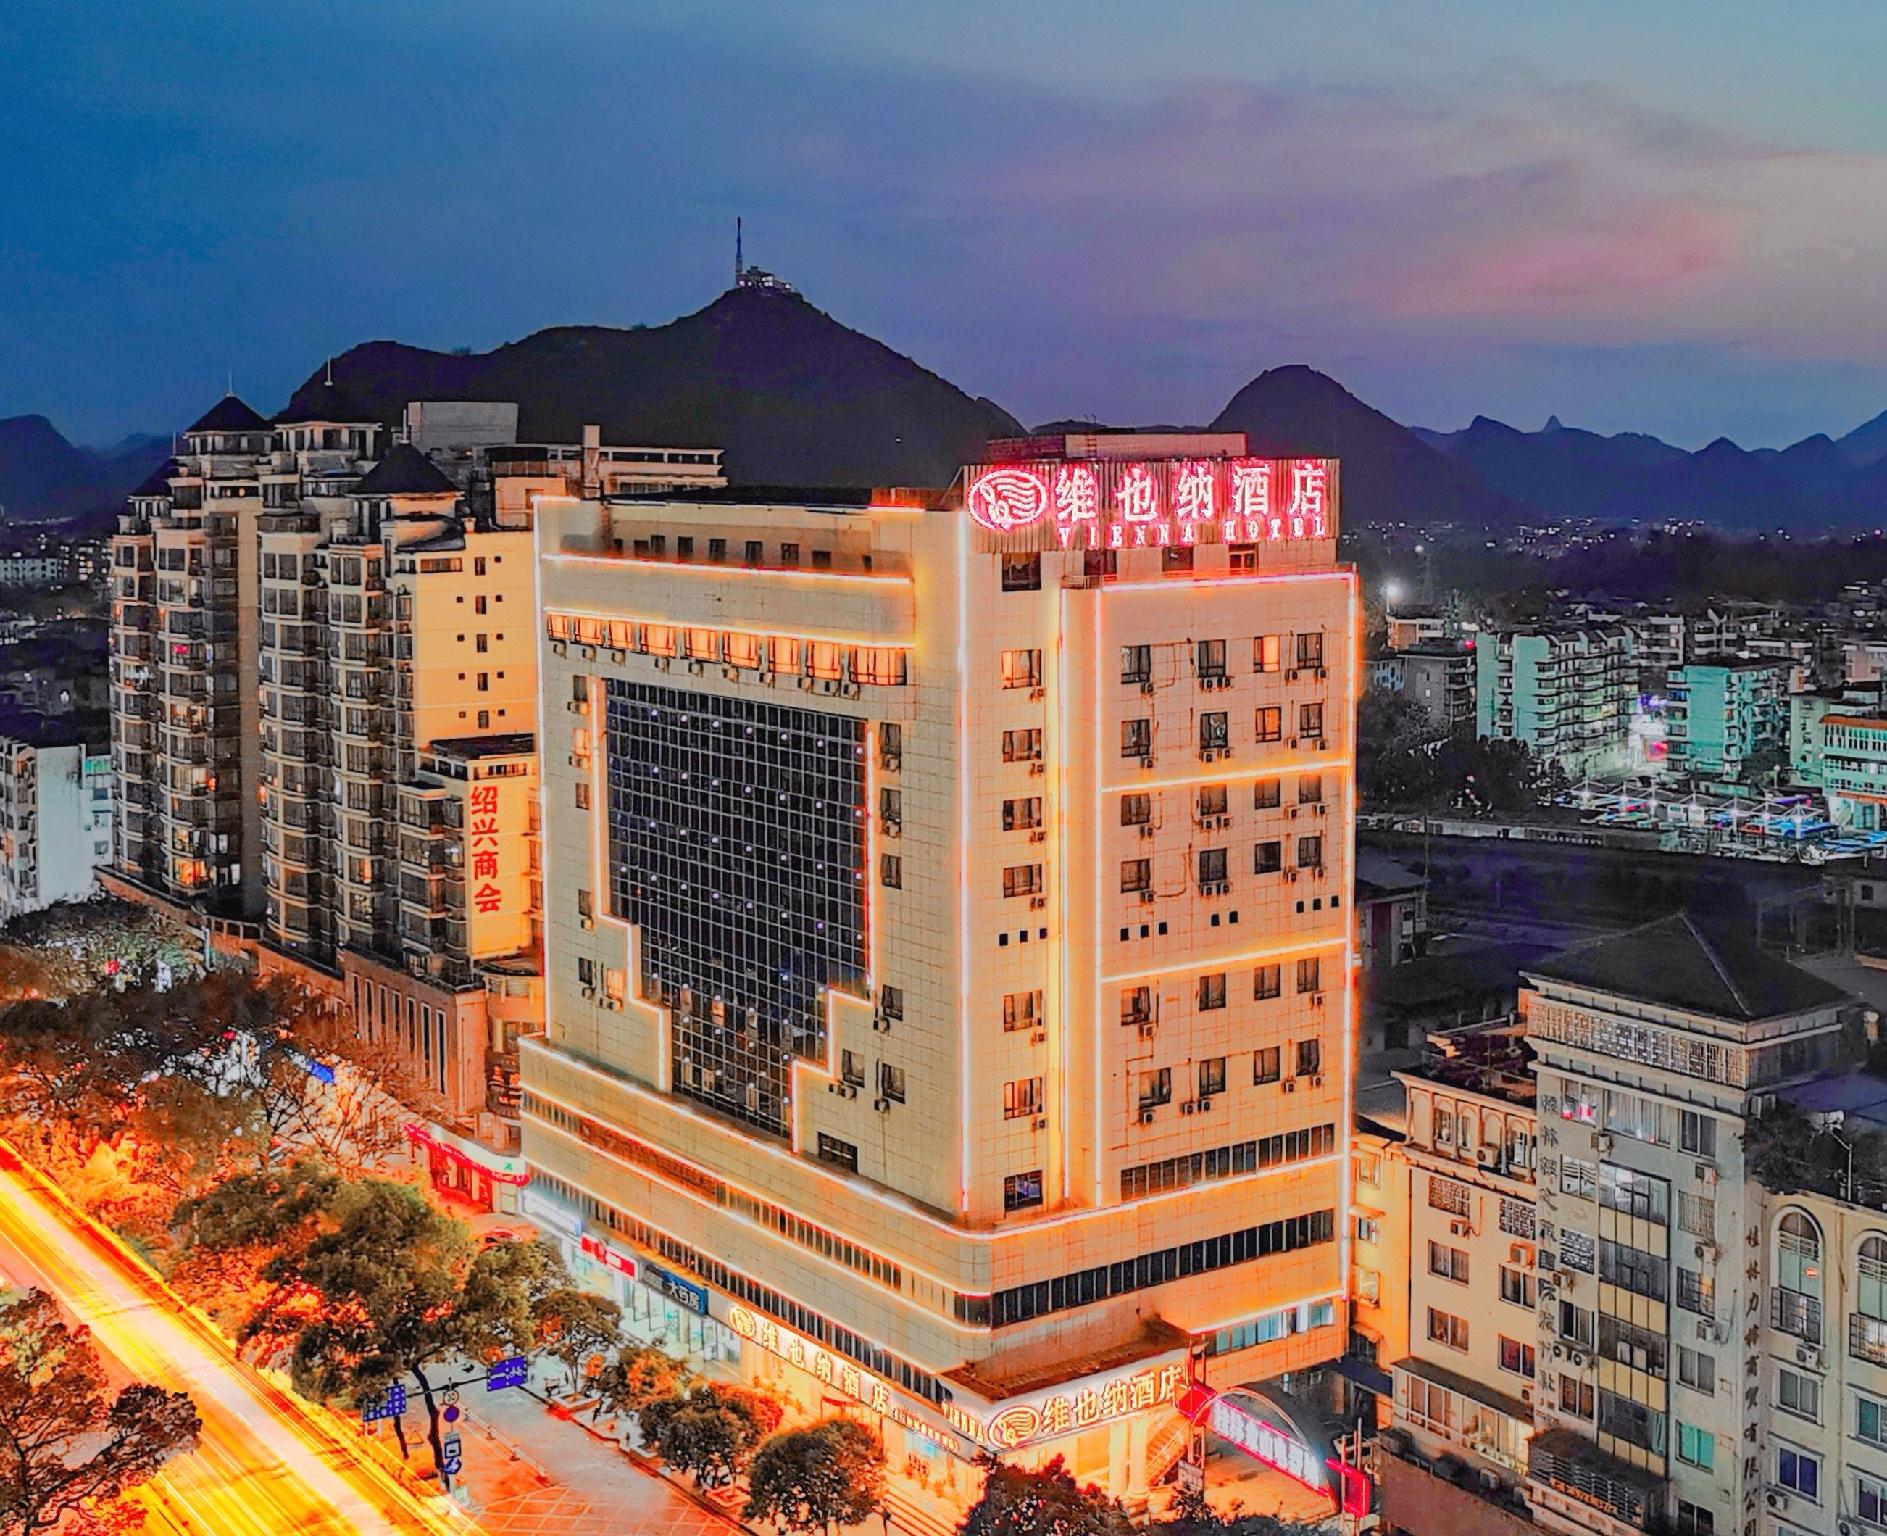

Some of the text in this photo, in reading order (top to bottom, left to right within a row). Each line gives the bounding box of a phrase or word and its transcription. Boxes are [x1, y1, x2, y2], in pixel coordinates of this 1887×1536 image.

[1055, 463, 1326, 522] 维也纳酒店
[1058, 517, 1326, 548] VIENNA HOTEL
[470, 785, 501, 913] 绍兴商会
[762, 1321, 889, 1414] 维也纳酒店
[1042, 1364, 1184, 1432] 维也纳酒店
